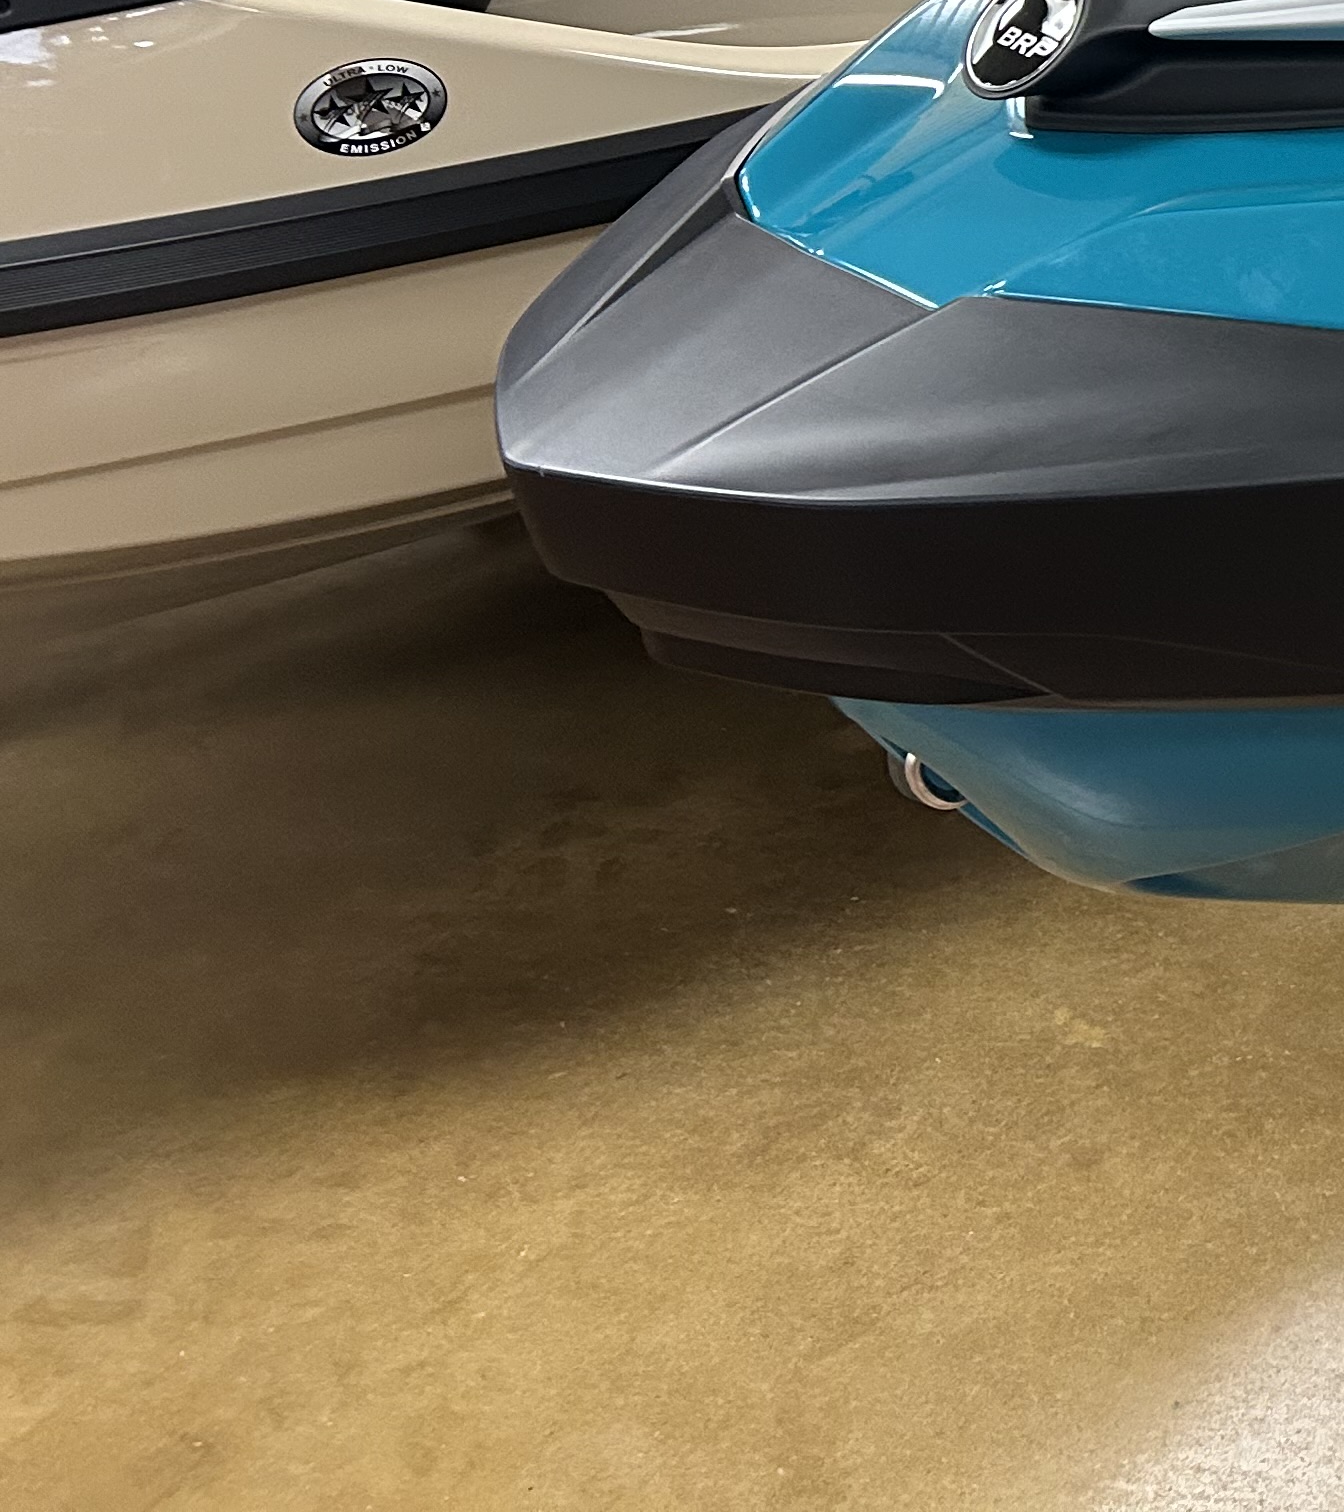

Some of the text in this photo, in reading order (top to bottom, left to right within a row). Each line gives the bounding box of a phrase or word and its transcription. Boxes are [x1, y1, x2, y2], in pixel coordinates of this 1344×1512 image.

[996, 25, 1060, 58] BRP
[322, 64, 410, 88] ULTRA LOW
[339, 129, 417, 154] EMISSION
